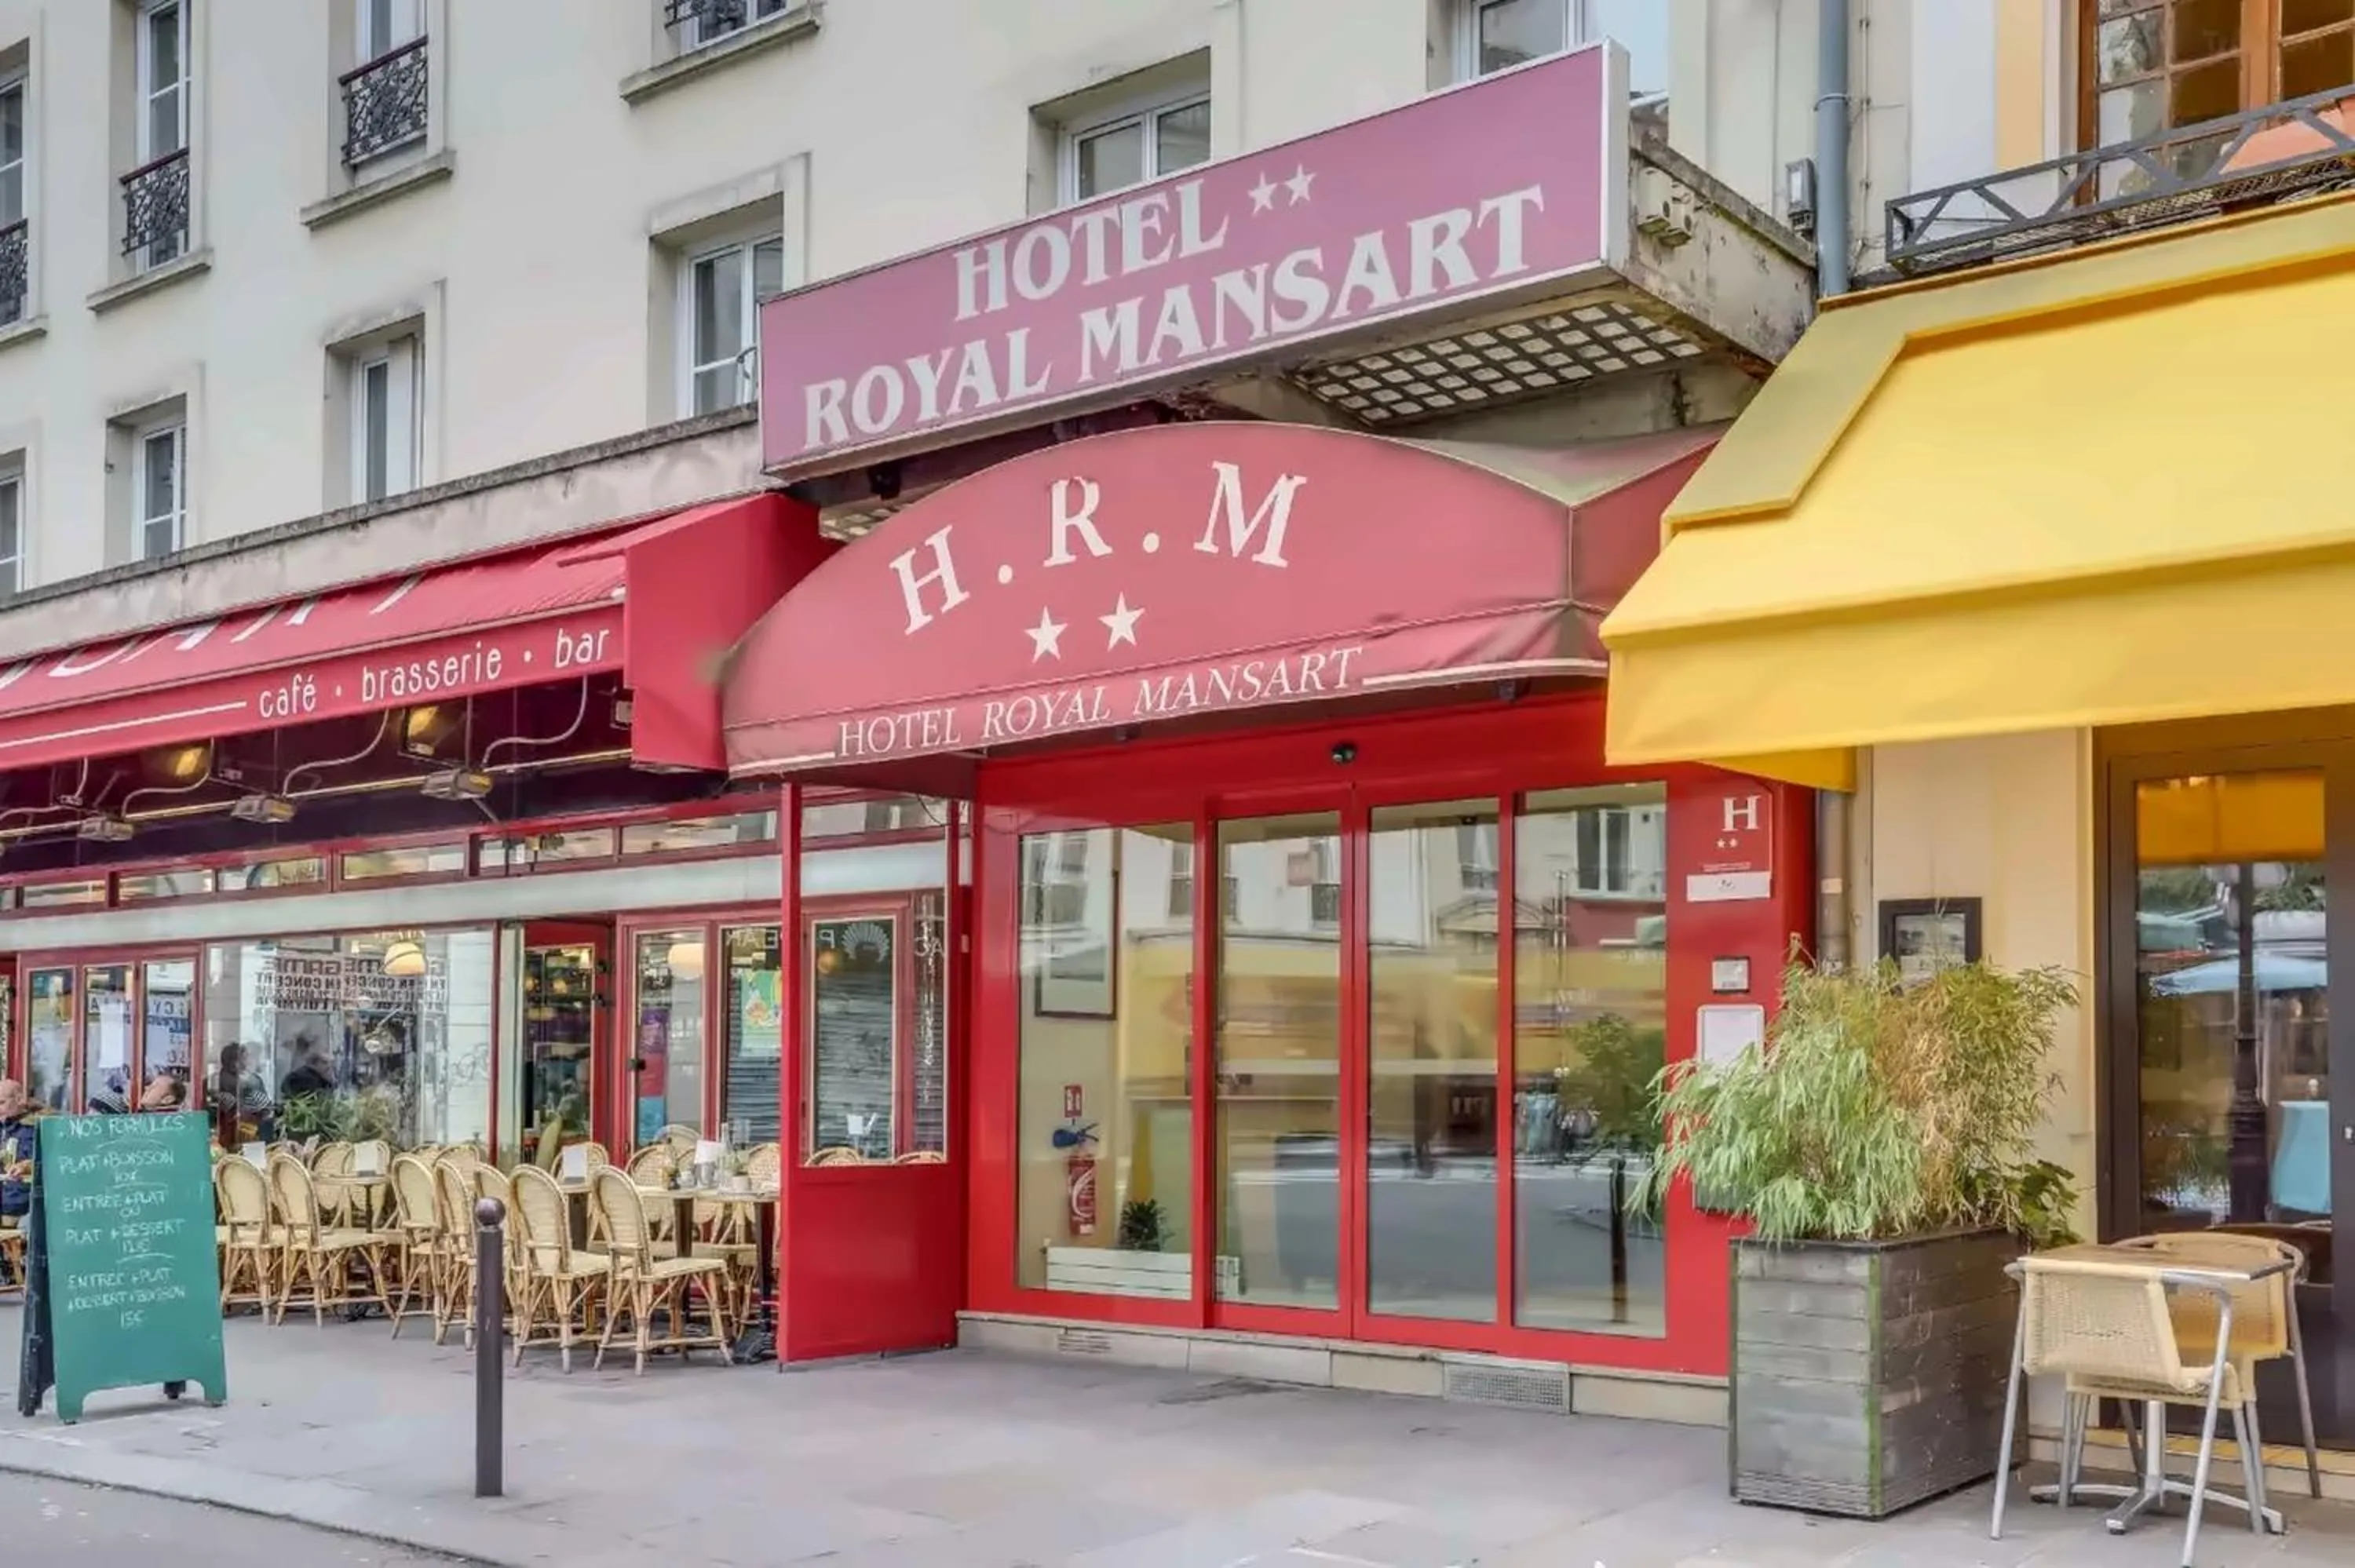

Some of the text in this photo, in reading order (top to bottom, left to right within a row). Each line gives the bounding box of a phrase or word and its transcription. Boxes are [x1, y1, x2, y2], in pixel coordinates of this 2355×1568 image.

[952, 179, 1230, 321] HOTEL
[803, 184, 1545, 450] ROYAL MANSART
[259, 628, 610, 717] café brasserie bar
[838, 647, 1363, 758] HOTEL ROYAL MANSART
[1722, 795, 1761, 833] H
[68, 1117, 102, 1138] NOS
[59, 1153, 100, 1175] PLAT
[65, 1227, 102, 1245] PLAT
